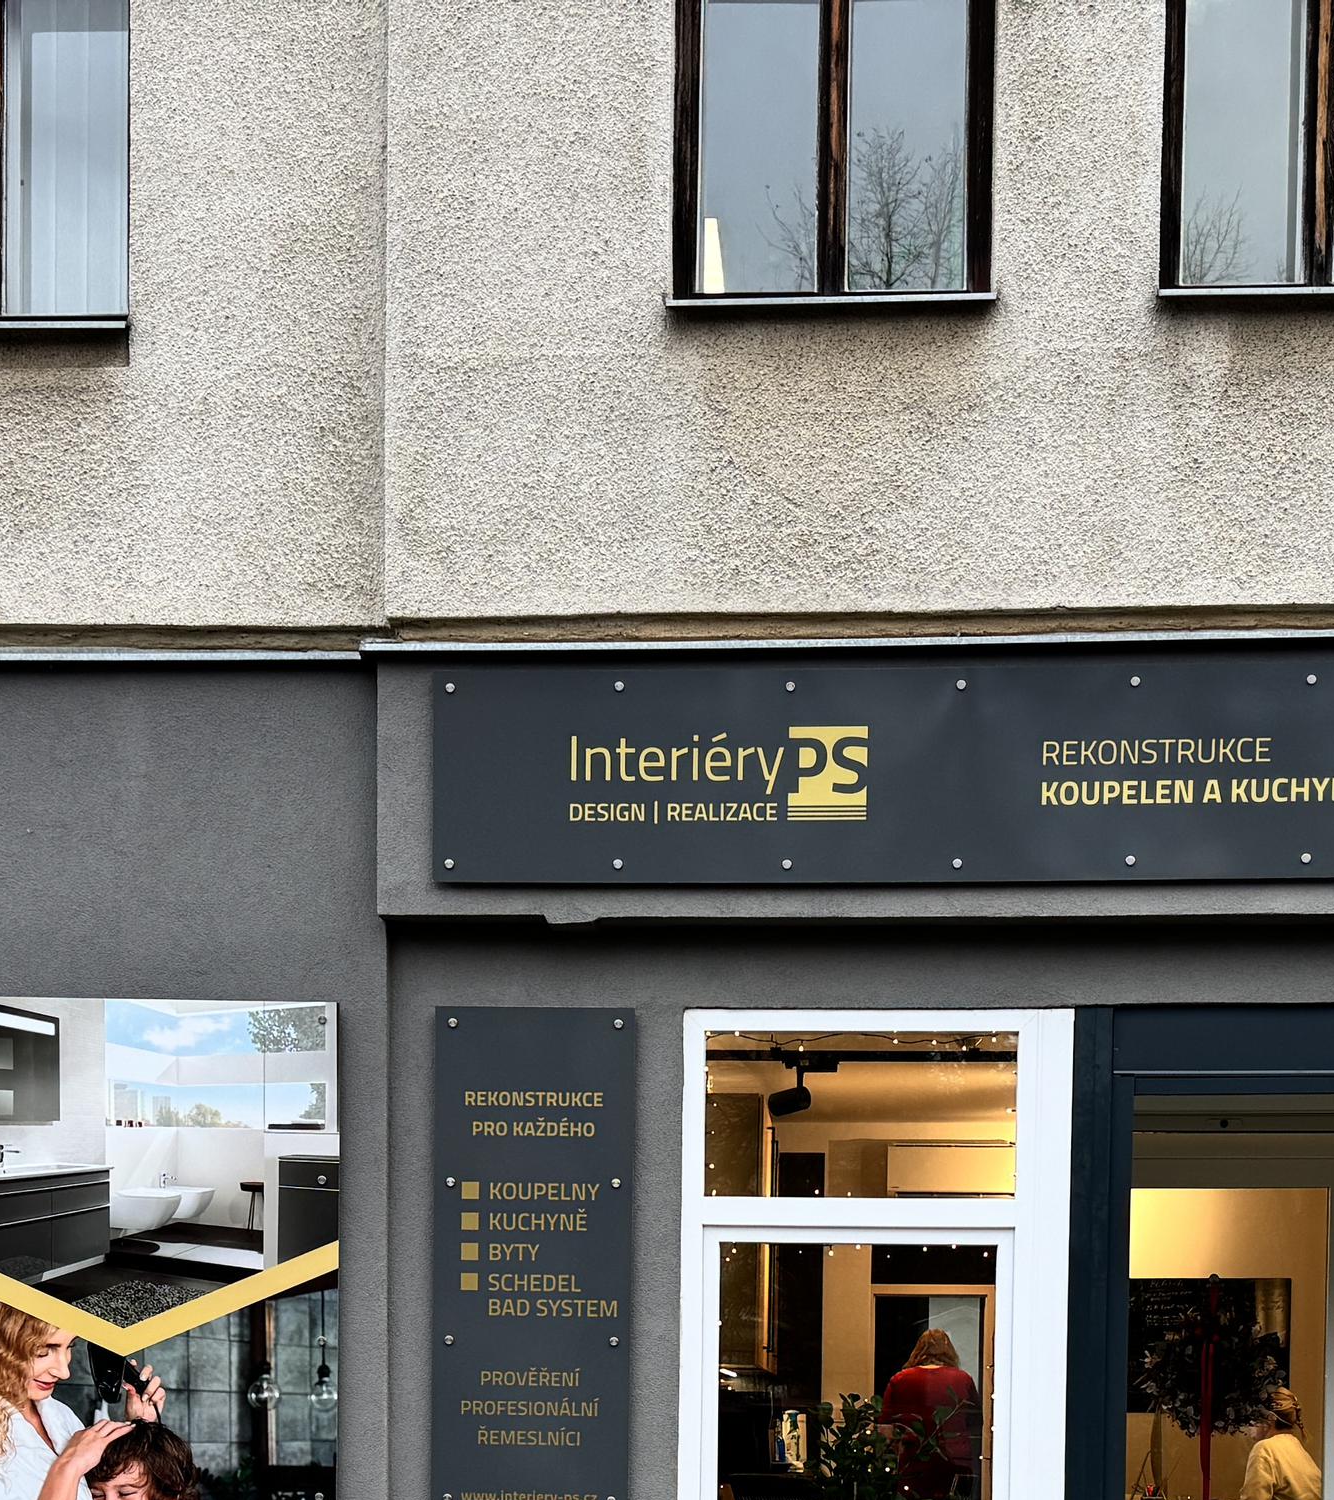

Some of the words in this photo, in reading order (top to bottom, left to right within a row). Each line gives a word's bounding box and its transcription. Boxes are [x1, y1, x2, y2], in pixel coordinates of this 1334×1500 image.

[1042, 737, 1273, 767] REKONSTRUKCE
[571, 732, 785, 795] Interiéry
[1041, 779, 1195, 806] KOUPELEN
[1203, 779, 1223, 804] A
[569, 803, 647, 823] DESIGN
[667, 803, 777, 823] REALIZACE
[465, 1091, 604, 1108] REKONSTRUKCE
[472, 1121, 508, 1137] PRO
[513, 1117, 596, 1138] KAŽDÉHO
[489, 1183, 599, 1201] KOUPELNY
[489, 1209, 588, 1232] KUCHYNĚ
[489, 1243, 539, 1262] BYTY
[488, 1274, 582, 1293] SCHEDEL
[488, 1298, 531, 1317] BAD
[536, 1299, 618, 1318] SYSTEM
[480, 1367, 581, 1387] PROVĚŘENÍ
[461, 1397, 600, 1417] PROFESIONÁLNÍ
[478, 1426, 581, 1447] ŘEMESLNÍCI
